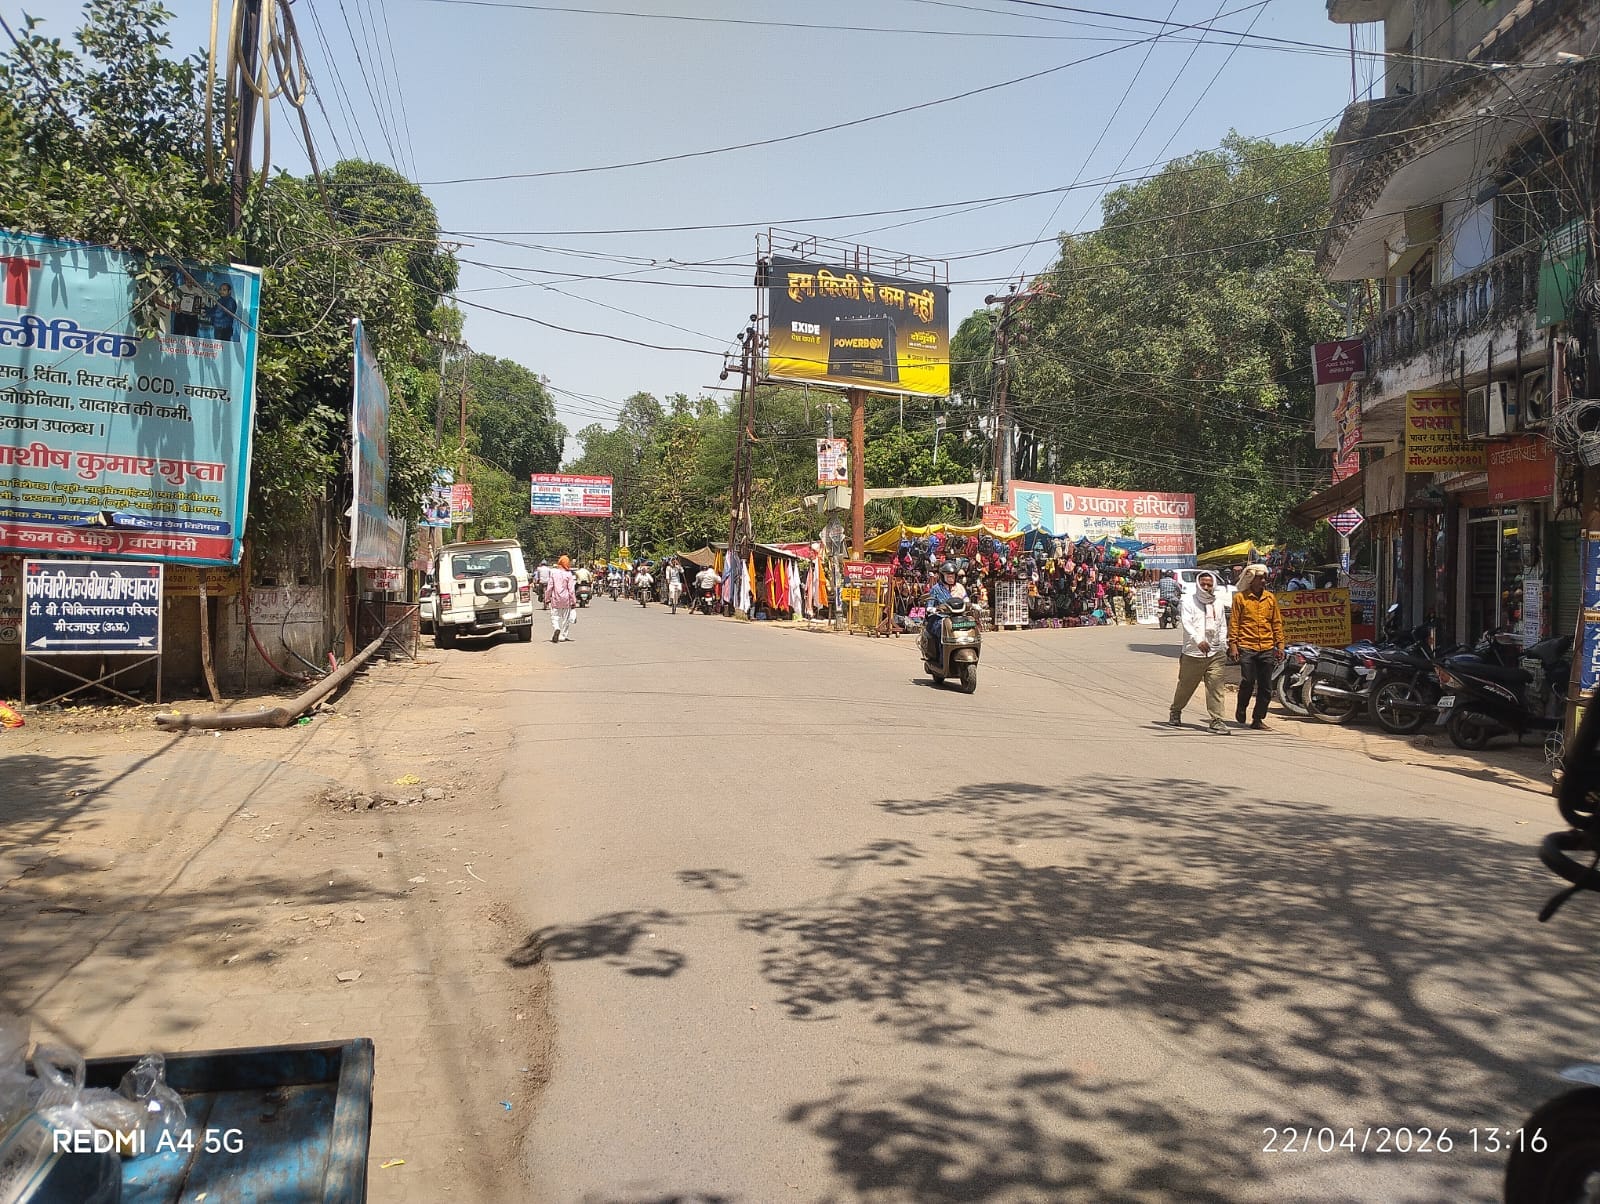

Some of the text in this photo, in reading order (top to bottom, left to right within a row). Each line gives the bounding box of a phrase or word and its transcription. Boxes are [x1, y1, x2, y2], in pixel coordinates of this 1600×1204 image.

[787, 269, 934, 324] हम किसी से कम नहीं
[791, 321, 820, 335] EXIDE
[833, 337, 883, 350] POWERBOX
[34, 364, 72, 386] चिंता,
[137, 376, 179, 397] OCD,
[183, 384, 231, 403] चक्कर,
[133, 401, 153, 417] की
[156, 403, 192, 423] कमी,
[41, 419, 94, 436] उपलब्ध
[77, 452, 153, 479] कुमार
[159, 458, 226, 485] गुप्ता
[1077, 496, 1129, 514] उपकार
[1132, 494, 1190, 516] हॉस्पिटल
[56, 530, 76, 544] के
[128, 537, 198, 551] वाराणसी
[30, 602, 42, 616] टी.
[61, 602, 125, 616] चिकित्सालय
[53, 619, 101, 634] मीरजापुर
